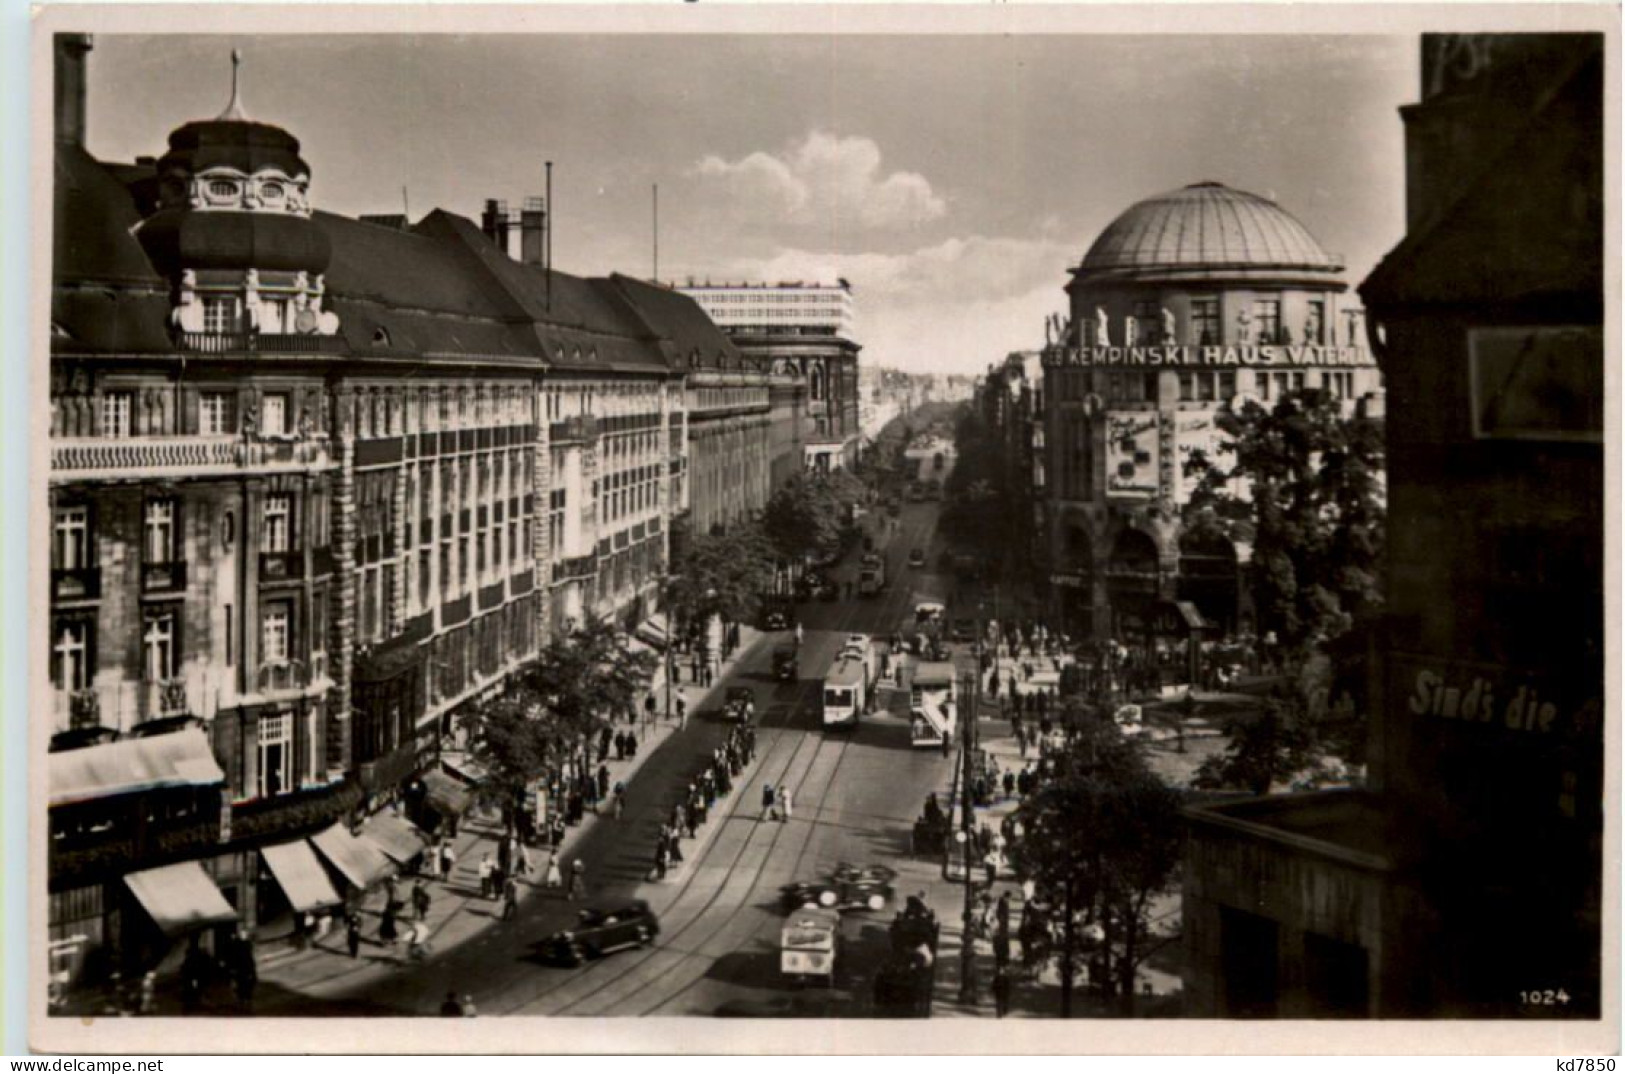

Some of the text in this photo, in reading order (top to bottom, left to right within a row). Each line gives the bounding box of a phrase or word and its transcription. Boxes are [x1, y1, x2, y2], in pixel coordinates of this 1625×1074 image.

[1069, 346, 1189, 366] KEMPINSKI
[1203, 345, 1275, 365] HAUS
[1504, 684, 1557, 734] die
